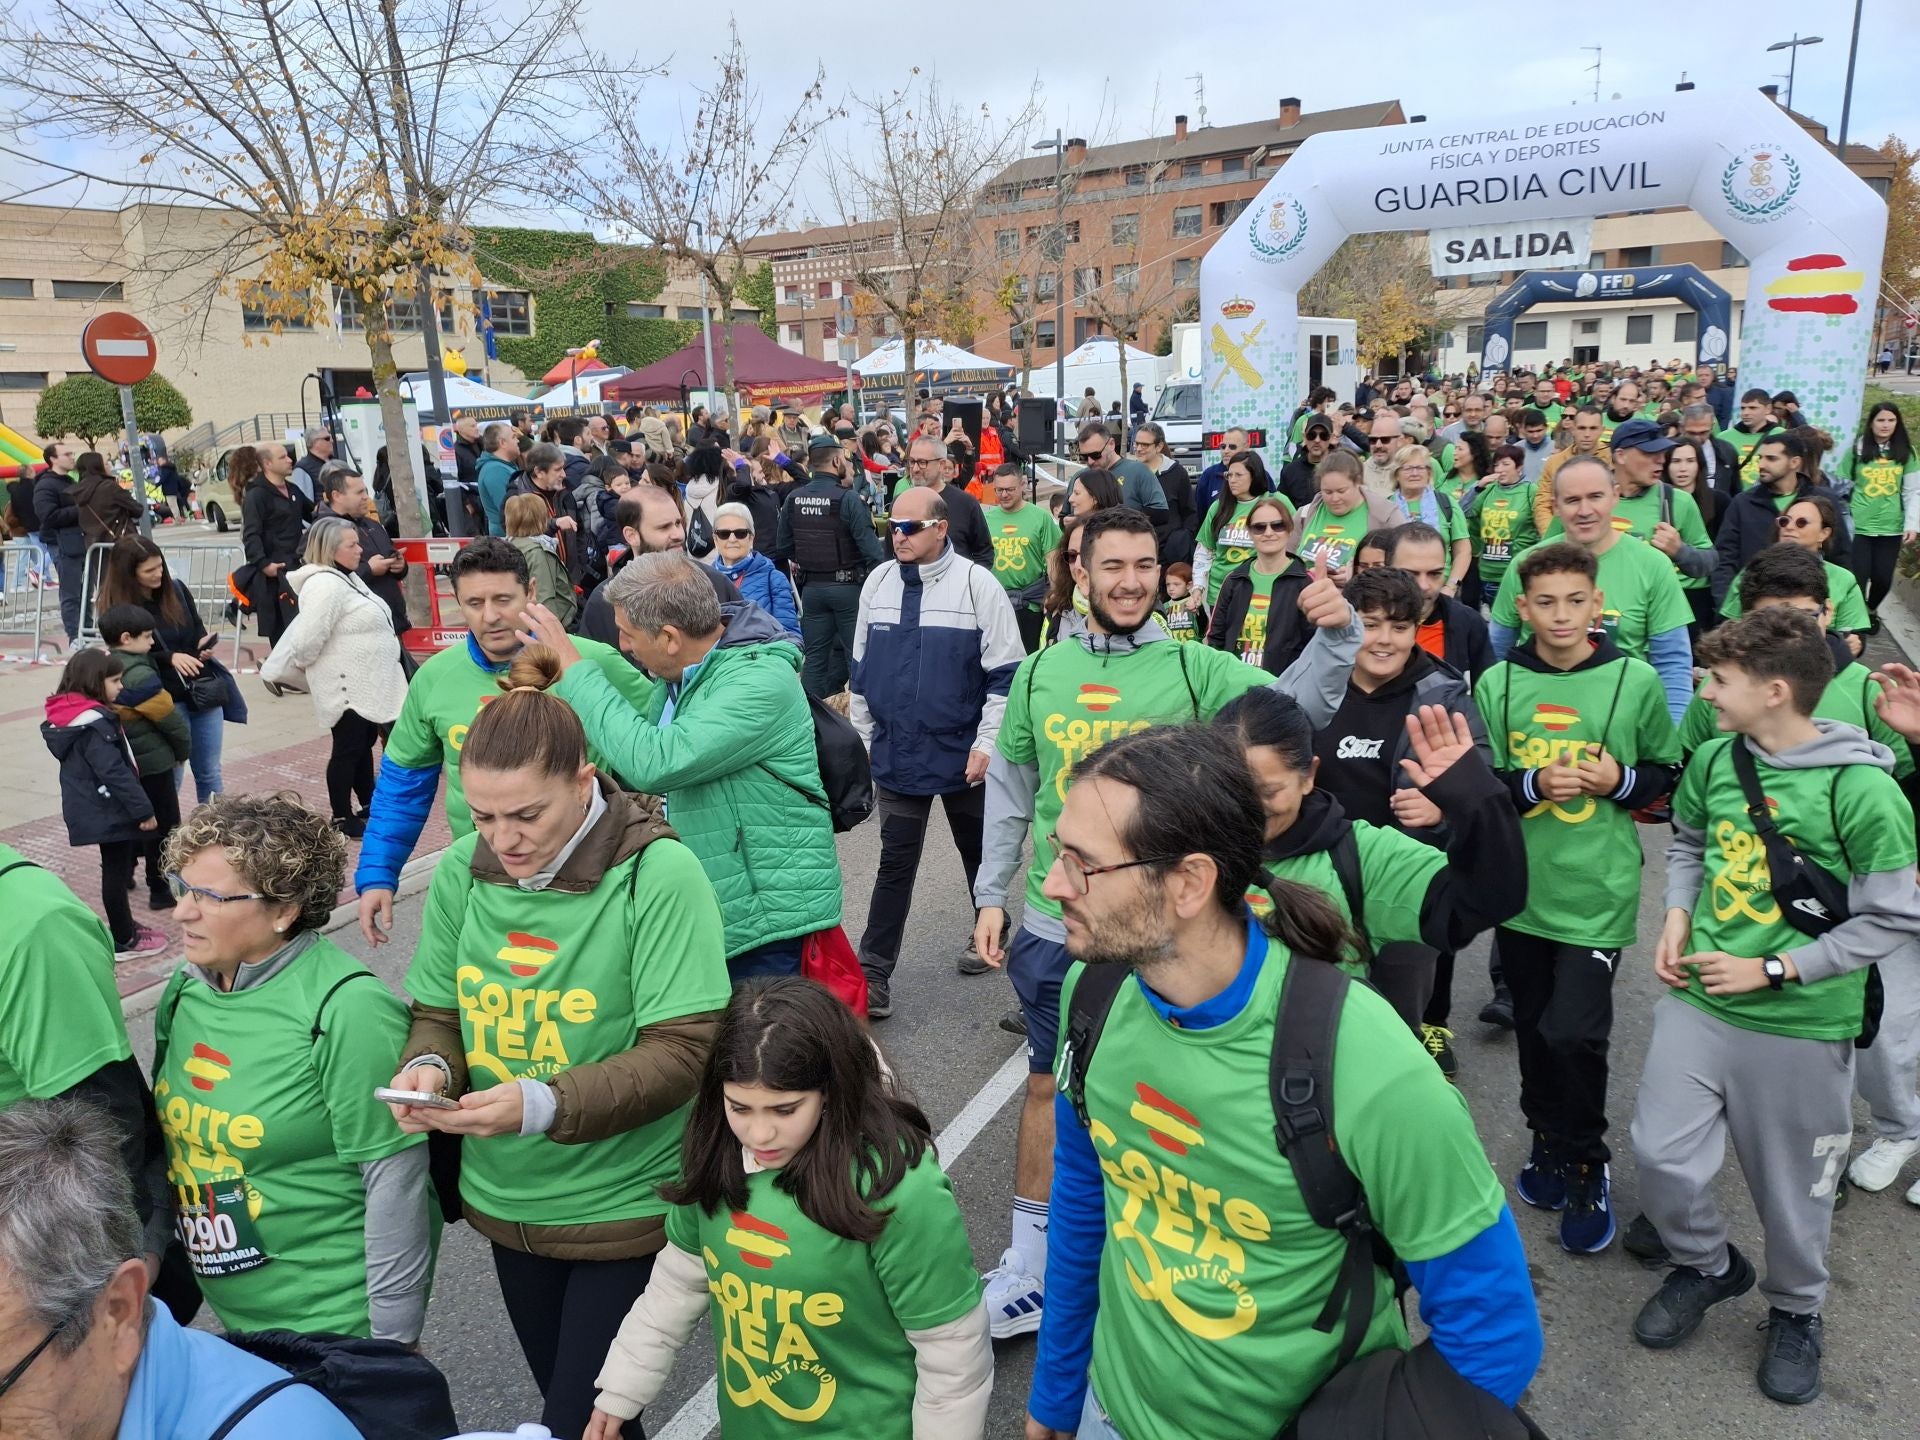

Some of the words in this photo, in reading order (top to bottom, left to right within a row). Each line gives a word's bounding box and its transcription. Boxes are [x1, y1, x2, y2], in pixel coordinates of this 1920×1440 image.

[1379, 137, 1434, 156] JUNTA
[1439, 128, 1520, 148] CENTRAL
[1524, 124, 1549, 140] DE
[1553, 109, 1666, 136] EDUCACIÓN
[1430, 149, 1484, 171] FÍSICA
[1487, 150, 1500, 164] Y
[1504, 137, 1602, 164] DEPORTES
[1374, 172, 1549, 213] GUARDIA
[1558, 161, 1662, 196] CIVIL
[1444, 230, 1576, 264] SALIDA
[1601, 274, 1635, 290] FFD
[880, 374, 905, 388] CIVI
[951, 369, 982, 383] GUARDIA
[982, 368, 998, 381] CIVIL
[464, 405, 507, 420] GUARDIA
[545, 407, 573, 420] UARDI
[794, 496, 831, 506] GUARDIA
[801, 507, 823, 516] CIVIL
[443, 632, 468, 640] COLO
[456, 965, 597, 1024] Corre
[466, 1008, 570, 1065] TEA
[516, 1063, 561, 1079] AUTIS
[1089, 1118, 1271, 1241] Corre
[202, 1265, 226, 1275] CIVIL
[1171, 1262, 1256, 1309] AUTISMO
[764, 1359, 834, 1388] AUTISMO
